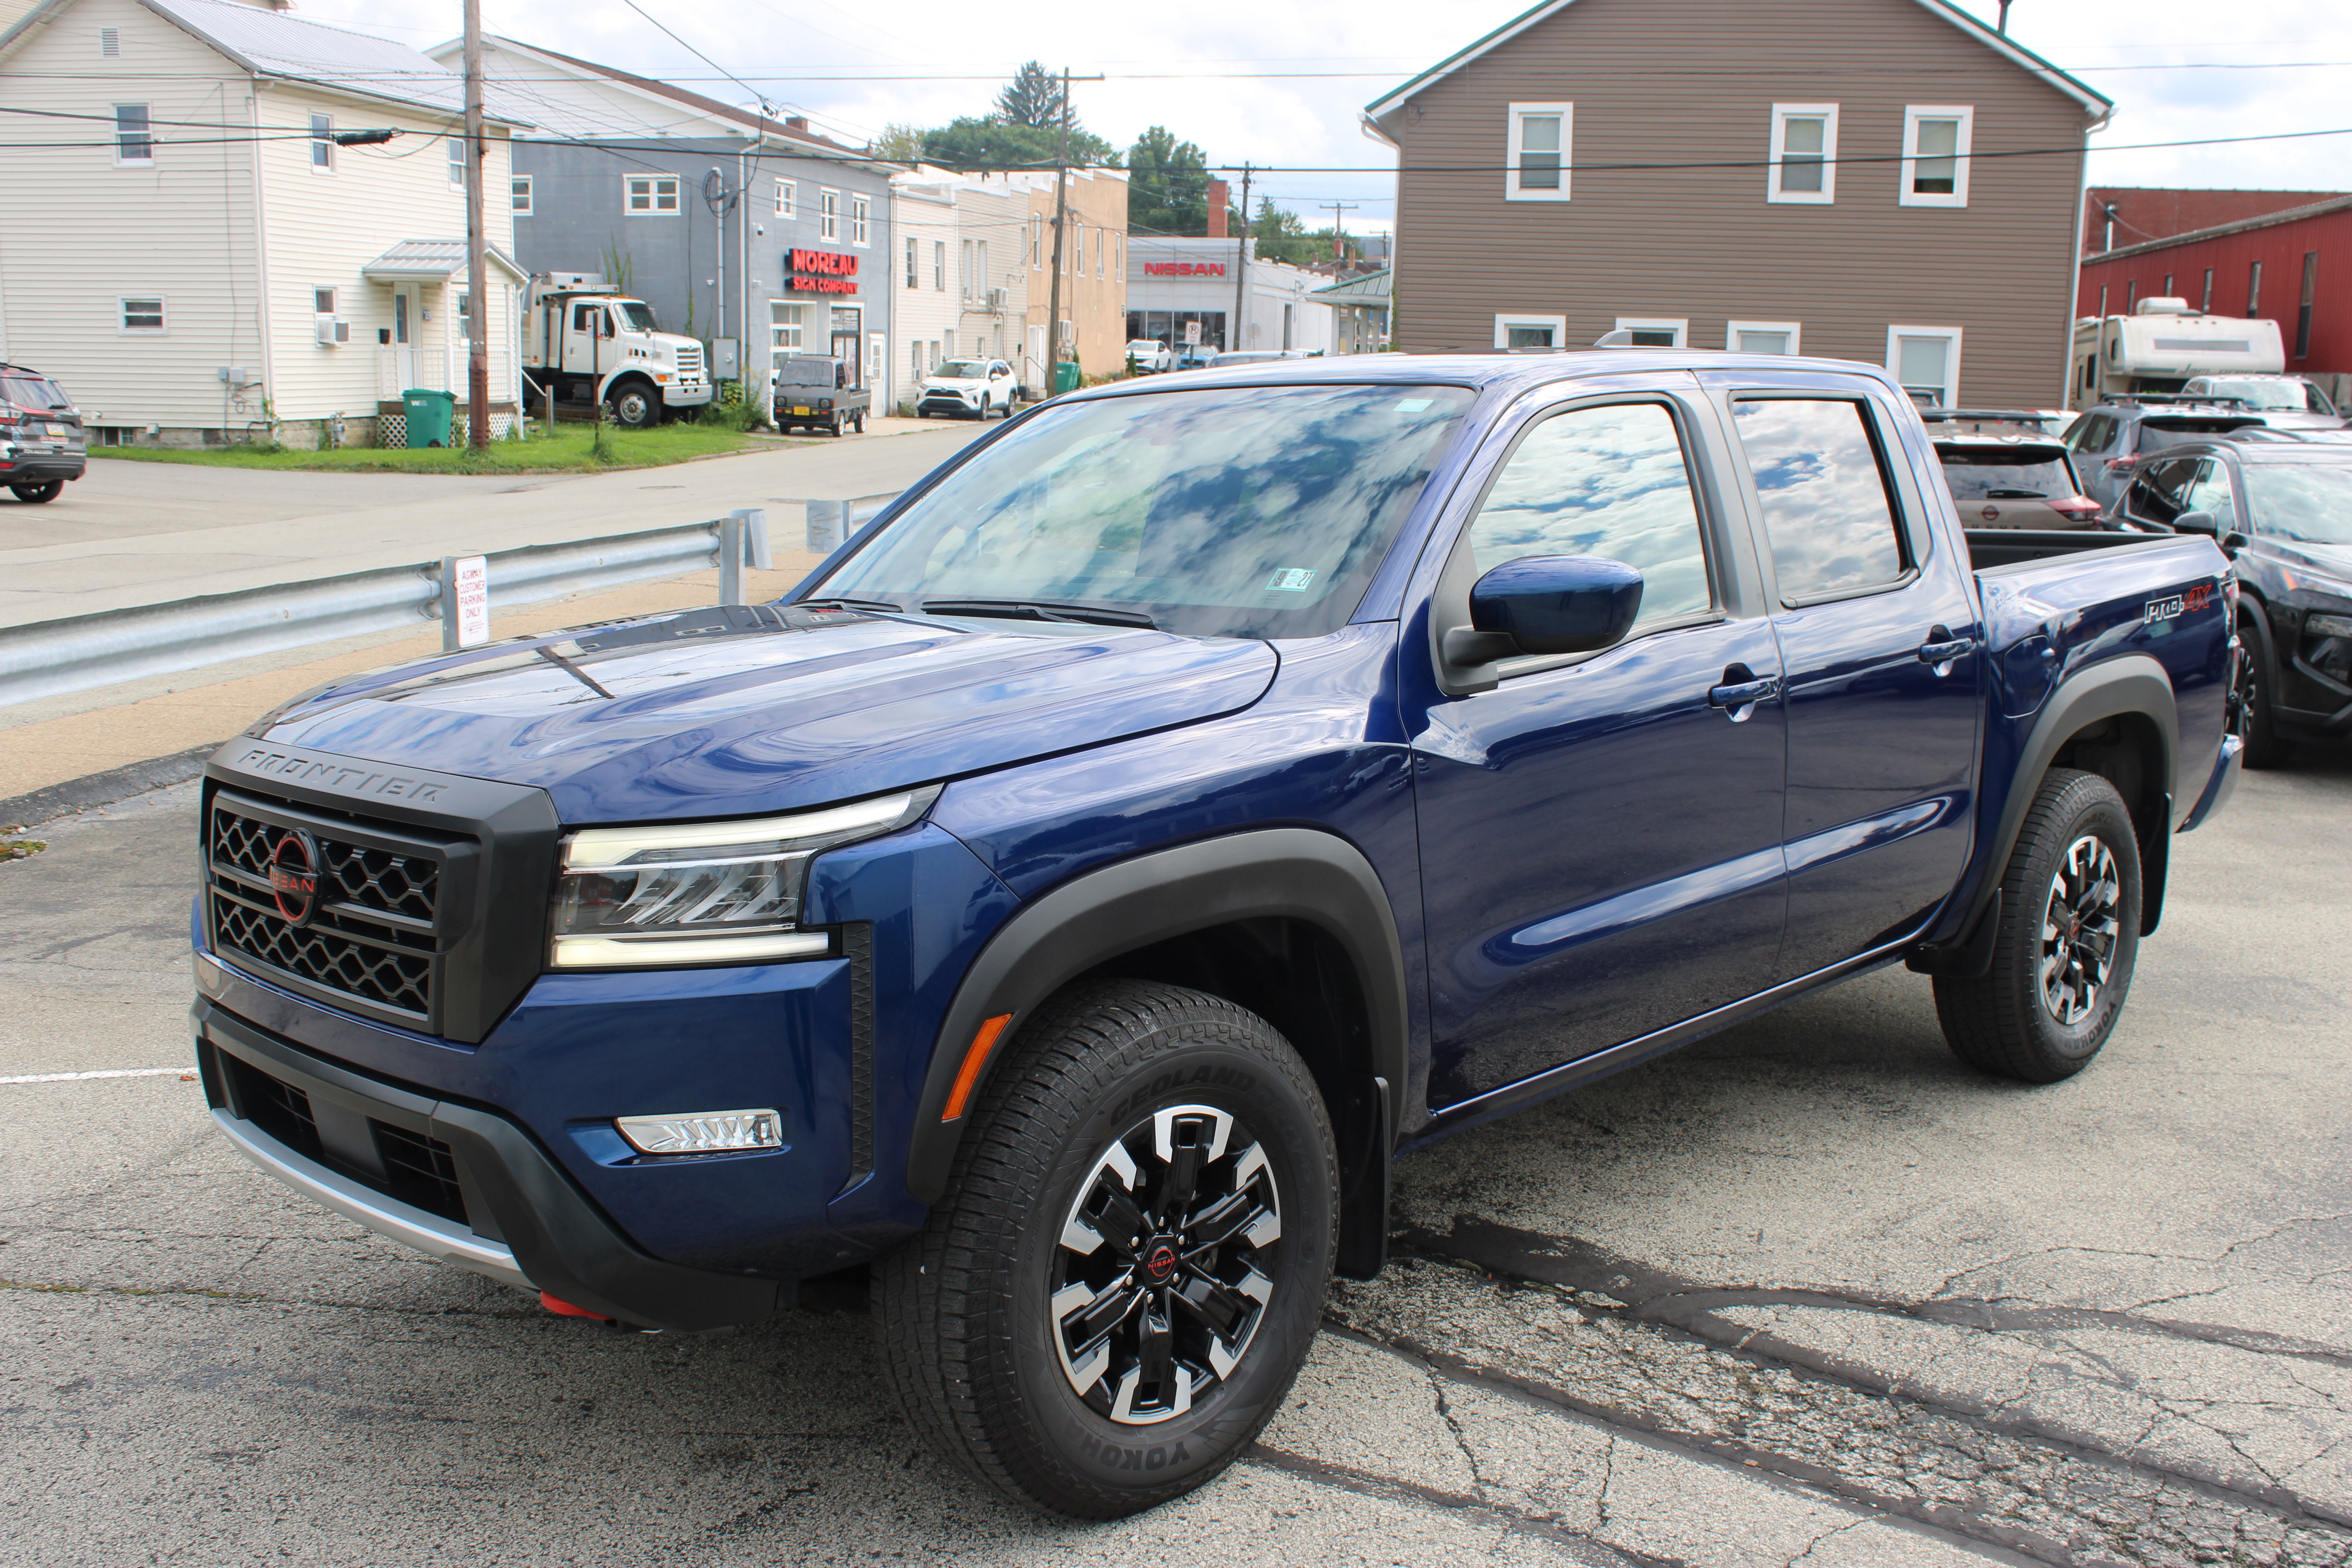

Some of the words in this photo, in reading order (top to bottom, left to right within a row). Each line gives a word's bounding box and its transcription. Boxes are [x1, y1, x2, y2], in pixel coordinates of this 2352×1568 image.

[793, 248, 858, 276] MOREAU
[1145, 262, 1224, 275] NISSAN
[793, 276, 816, 291] SIGN
[817, 278, 858, 294] COMPANY
[462, 568, 483, 581] AGWAY
[1296, 572, 1314, 587] 27
[460, 580, 485, 594] CUSTOMER
[460, 593, 485, 607] PARKING
[466, 606, 481, 618] ONLY
[237, 749, 450, 804] FRONTIER
[1148, 1255, 1175, 1269] NISSAN
